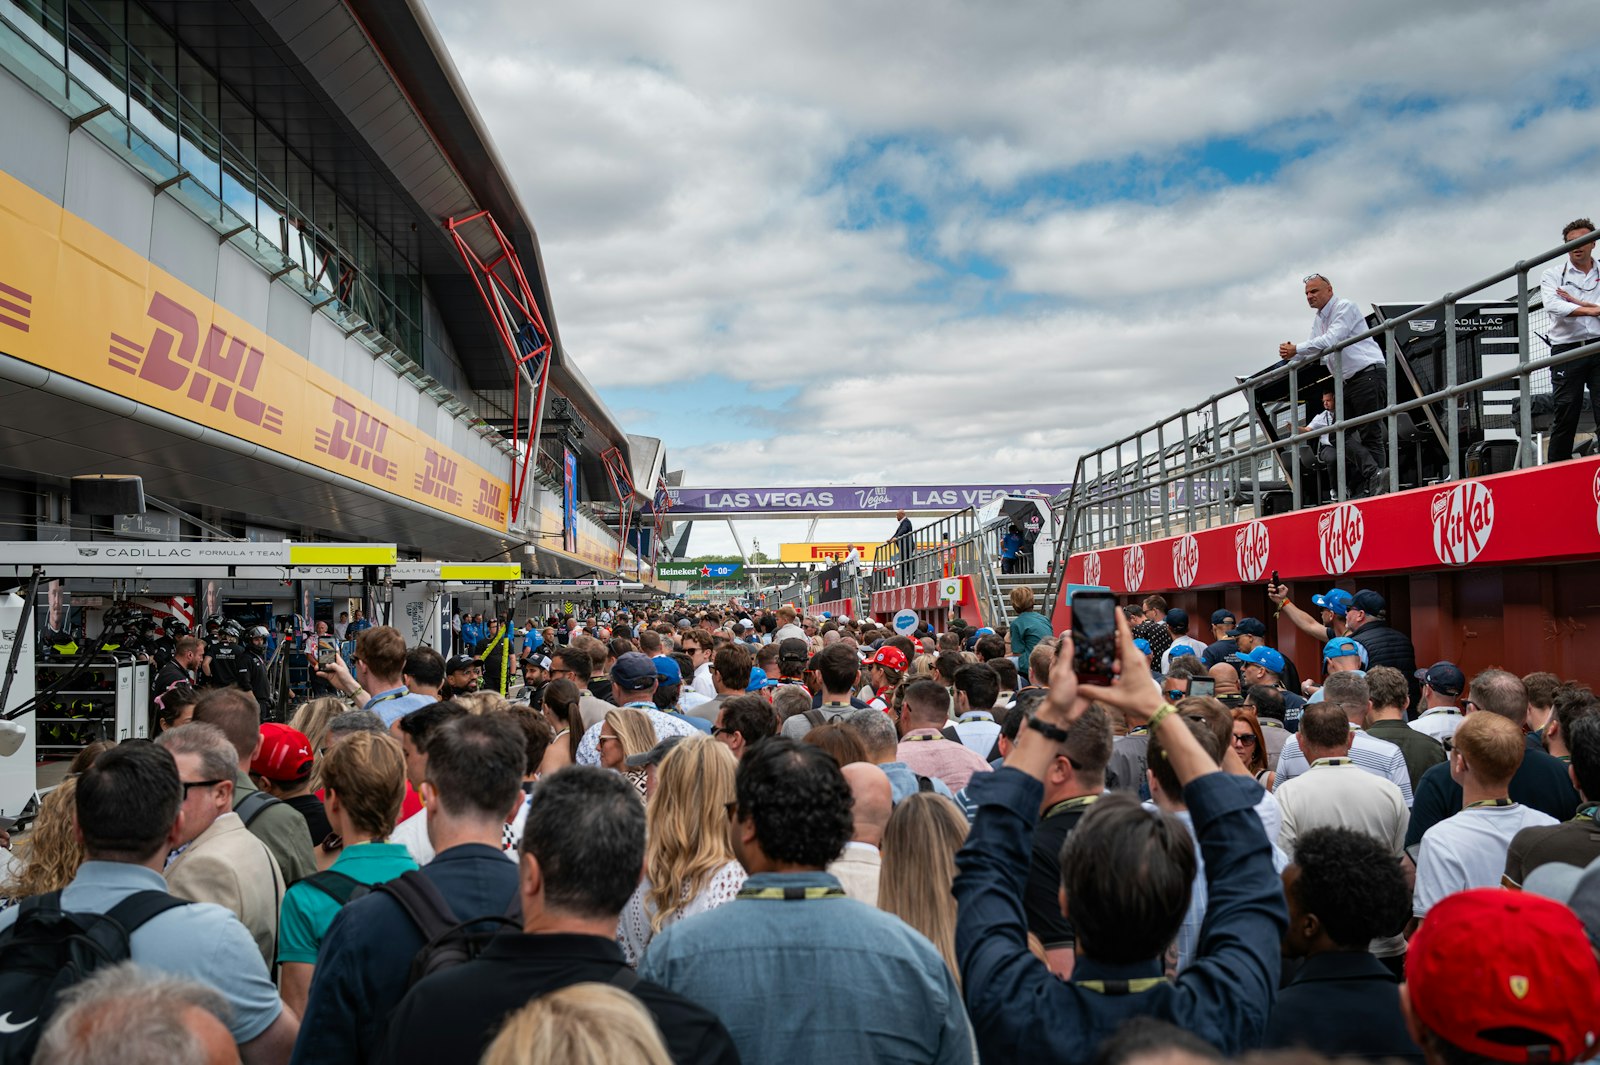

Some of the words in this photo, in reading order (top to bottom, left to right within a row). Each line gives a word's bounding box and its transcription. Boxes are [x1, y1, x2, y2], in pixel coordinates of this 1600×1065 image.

[138, 291, 266, 426] DHL
[328, 396, 388, 477] DHL
[421, 447, 457, 504] DHL
[912, 490, 958, 506] LAS
[477, 478, 501, 523] DHL
[704, 493, 751, 508] LAS
[754, 492, 834, 507] VEGAS
[855, 488, 892, 509] Vegas
[1325, 505, 1361, 574] KitKat
[1440, 483, 1490, 564] KitKat
[105, 548, 192, 557] CADILLAC
[660, 567, 697, 576] Heineken
[811, 546, 865, 559] PIREI
[1239, 521, 1267, 582] KitKat
